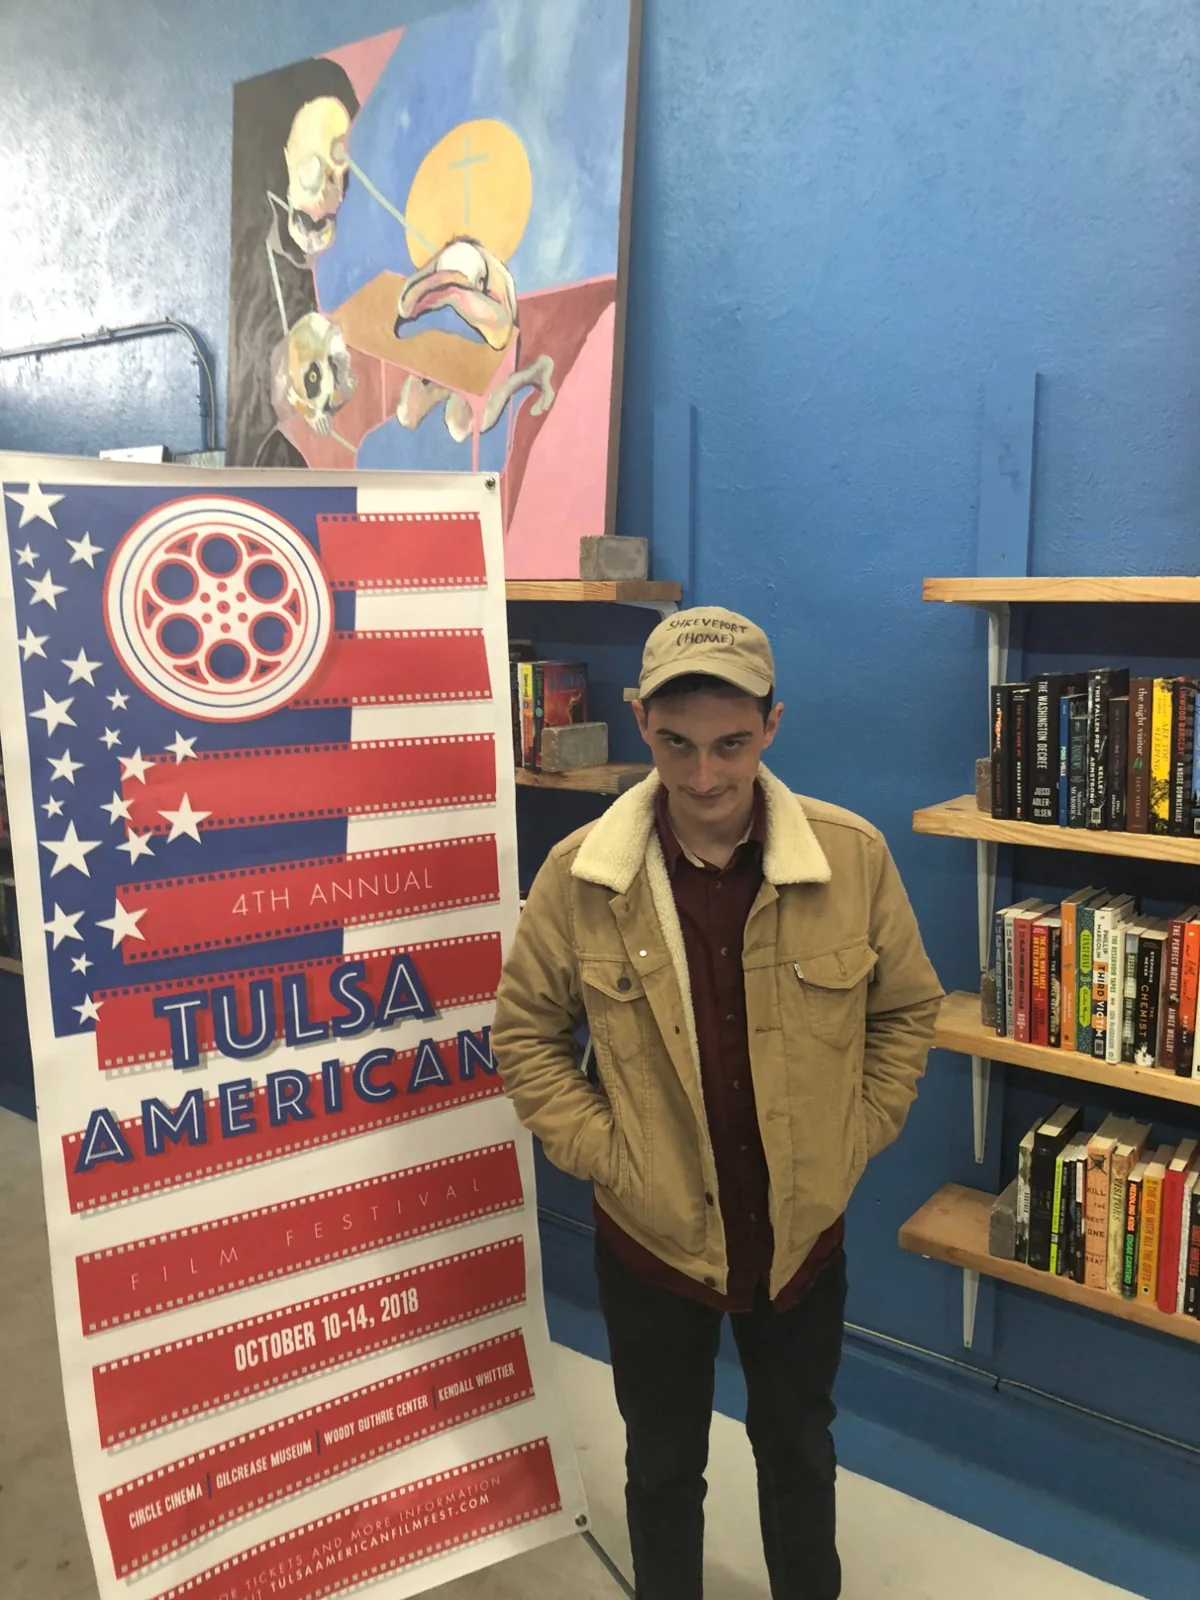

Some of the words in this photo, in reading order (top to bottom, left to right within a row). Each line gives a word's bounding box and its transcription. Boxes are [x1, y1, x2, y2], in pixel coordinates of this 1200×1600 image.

[666, 618, 748, 634] SHREVEPORT
[677, 632, 735, 646] (HOME)
[1037, 681, 1048, 693] THE
[1138, 688, 1148, 701] the
[1135, 704, 1147, 726] night
[1178, 687, 1186, 720] LINWOOD
[1036, 695, 1048, 741] WASHINGTON
[1136, 728, 1145, 755] visitor
[1177, 722, 1186, 756] BARCLAY
[1036, 743, 1048, 769] DECREE
[1033, 808, 1052, 817] OLSEN
[1175, 786, 1183, 823] DOWNSTAIRS
[231, 887, 290, 916] 4TH
[309, 868, 433, 906] ANNUAL
[1172, 924, 1181, 936] THE
[1081, 934, 1090, 969] TANGERINE
[1171, 938, 1180, 964] PERFECT
[1033, 968, 1039, 976] AN
[1096, 964, 1106, 996] THIRD
[1169, 966, 1178, 991] MOTHER
[152, 953, 438, 1071] TULSA
[1095, 1001, 1104, 1037] VICTIM
[1139, 984, 1149, 1038] CHEMIST
[1168, 1007, 1176, 1025] AIMEE
[1166, 1028, 1175, 1053] MOLLOY
[73, 1025, 499, 1173] AMERICAN
[1086, 1187, 1106, 1196] KILL
[1112, 1177, 1123, 1221] VISITORS
[1128, 1183, 1137, 1215] MEDDLING
[1147, 1186, 1157, 1198] THE
[1146, 1200, 1157, 1214] GIRL
[130, 1246, 239, 1292] FILM
[285, 1177, 480, 1247] FESTIVAL
[1087, 1228, 1105, 1238] ONE
[1127, 1216, 1135, 1231] KIDS
[1145, 1217, 1156, 1235] WITH
[1126, 1234, 1134, 1254] EDGAR
[1144, 1236, 1155, 1247] ALL
[1143, 1249, 1154, 1261] THE
[1125, 1255, 1133, 1284] CANTERO
[1142, 1262, 1152, 1282] GIFTS
[234, 1321, 316, 1372] OCTOBER
[321, 1308, 375, 1342] 10-14,
[380, 1287, 420, 1322] 2018
[438, 1378, 474, 1402] KENDALL
[475, 1362, 515, 1387] WHITTIER
[323, 1422, 355, 1446] WOODY
[358, 1409, 395, 1432] GUTHRIE
[396, 1394, 428, 1418] CENTER
[215, 1456, 268, 1489] GILCREASE
[270, 1439, 312, 1468] MUSEUM
[128, 1499, 163, 1530] CIRCLE
[164, 1482, 203, 1513] CINEMA
[245, 1554, 303, 1591] TICKETS
[312, 1536, 342, 1560] AND
[351, 1516, 391, 1542] MORE
[400, 1476, 501, 1522] INFORMATION
[270, 1493, 490, 1594] TULSAAMERICANFILMFEST.COM
